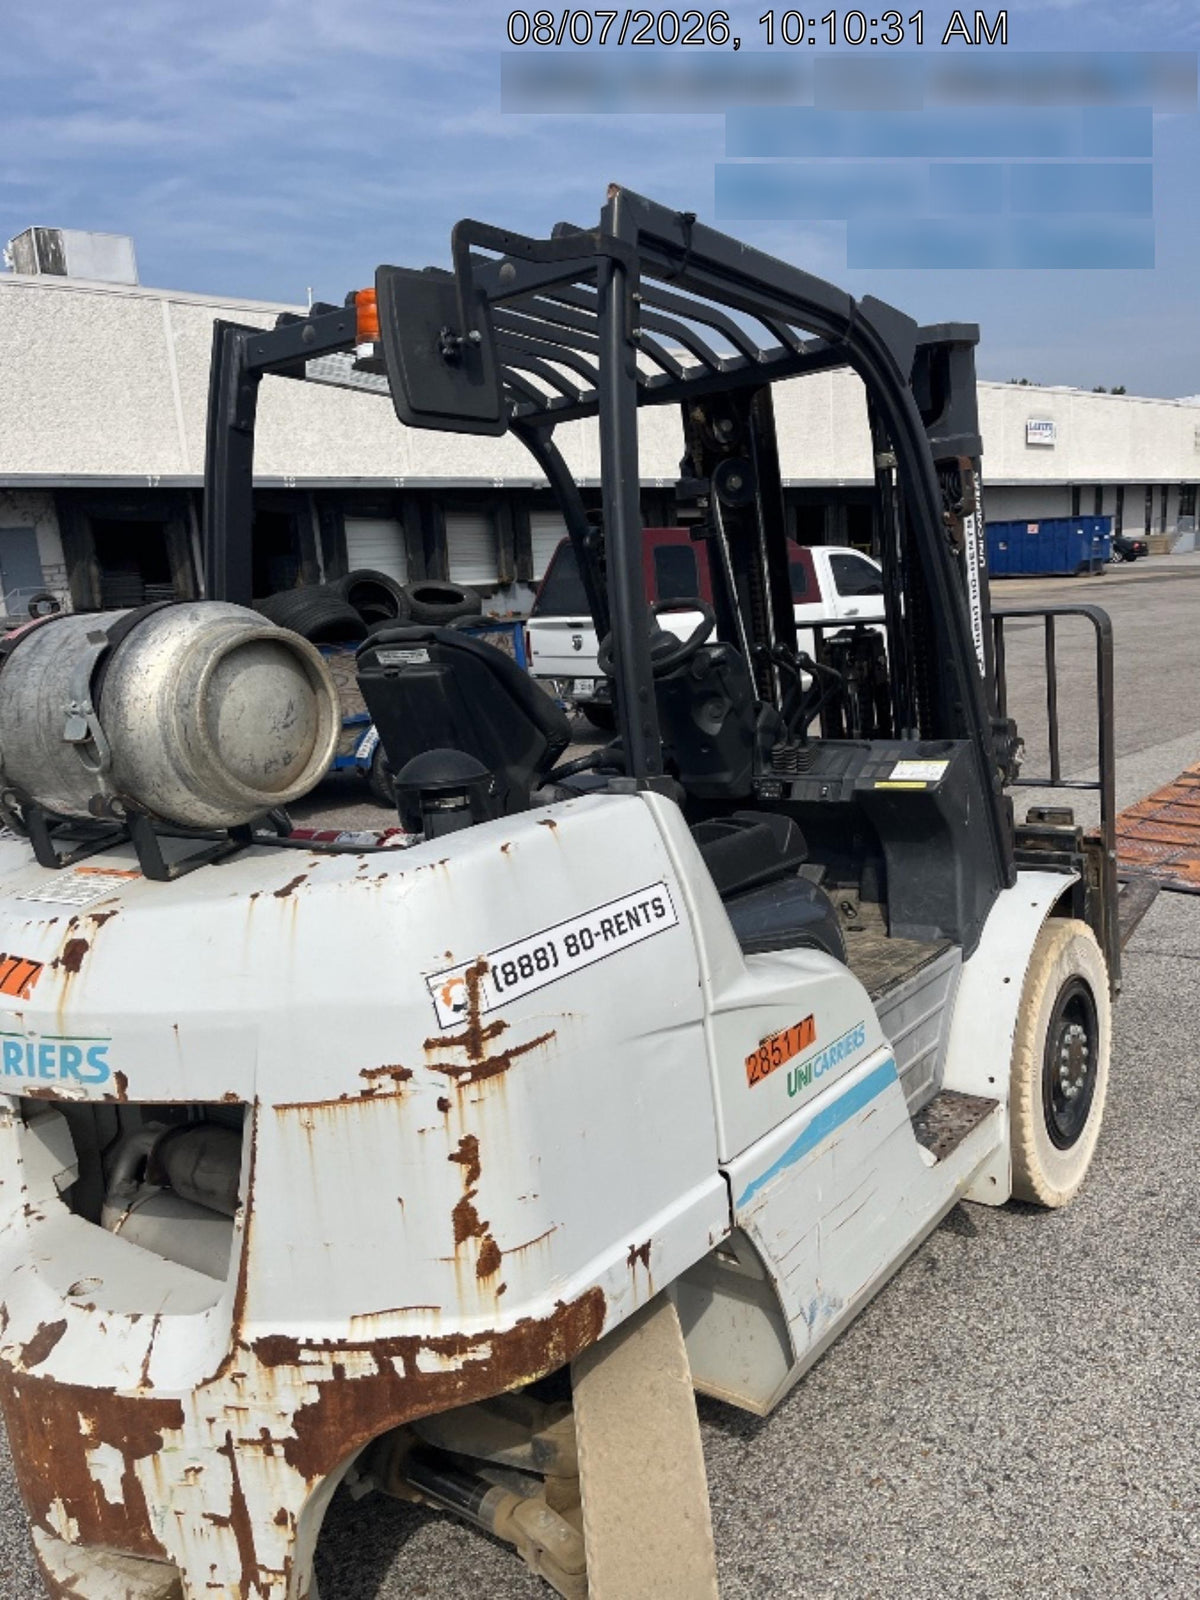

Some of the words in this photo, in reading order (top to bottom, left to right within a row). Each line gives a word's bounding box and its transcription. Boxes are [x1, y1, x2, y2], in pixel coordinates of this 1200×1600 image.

[491, 941, 559, 992] (888)
[564, 897, 666, 957] 80-RENTS
[0, 1041, 110, 1083] RIERS
[787, 1024, 865, 1097] UNICARRIERS
